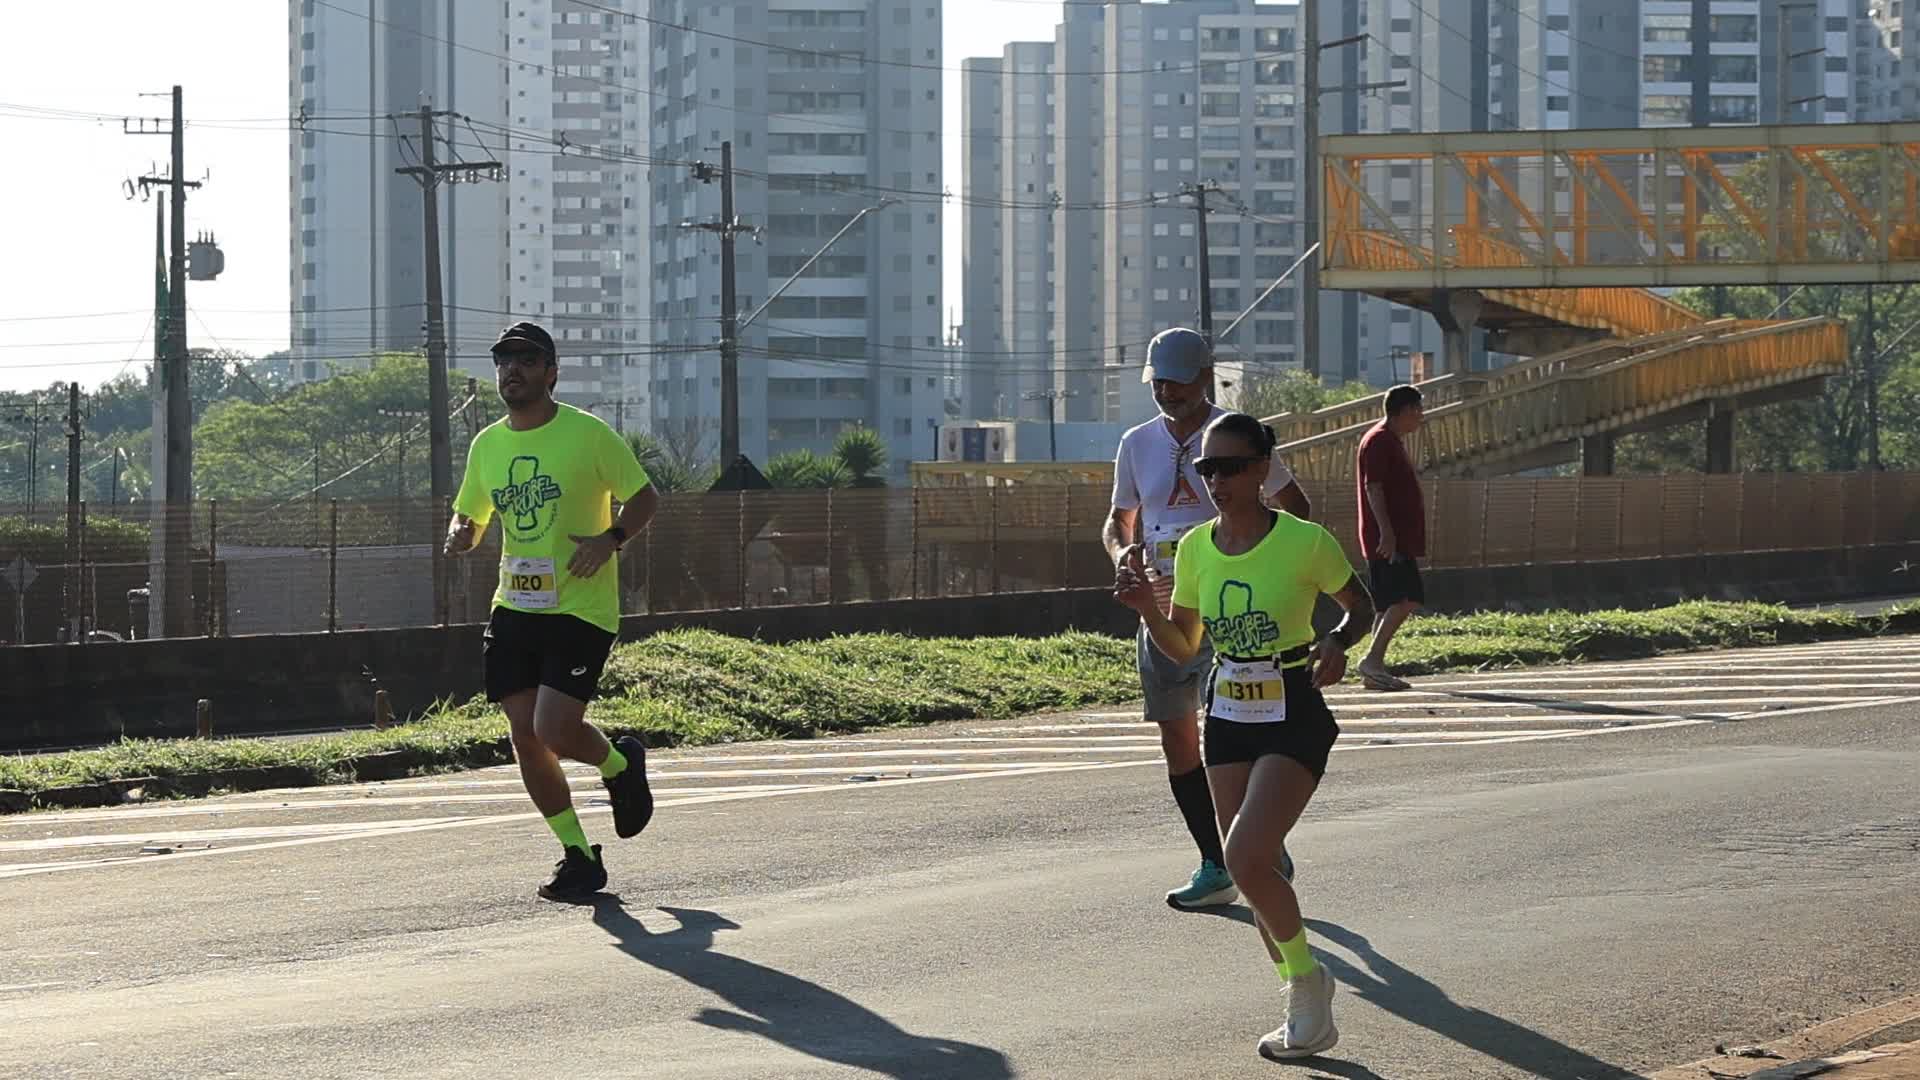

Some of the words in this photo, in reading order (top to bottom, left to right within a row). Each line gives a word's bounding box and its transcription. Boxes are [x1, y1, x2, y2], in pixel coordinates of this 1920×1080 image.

[513, 494, 544, 514] RUN
[511, 575, 542, 591] 1120
[1230, 628, 1262, 652] RUN
[1227, 681, 1264, 700] 1311
